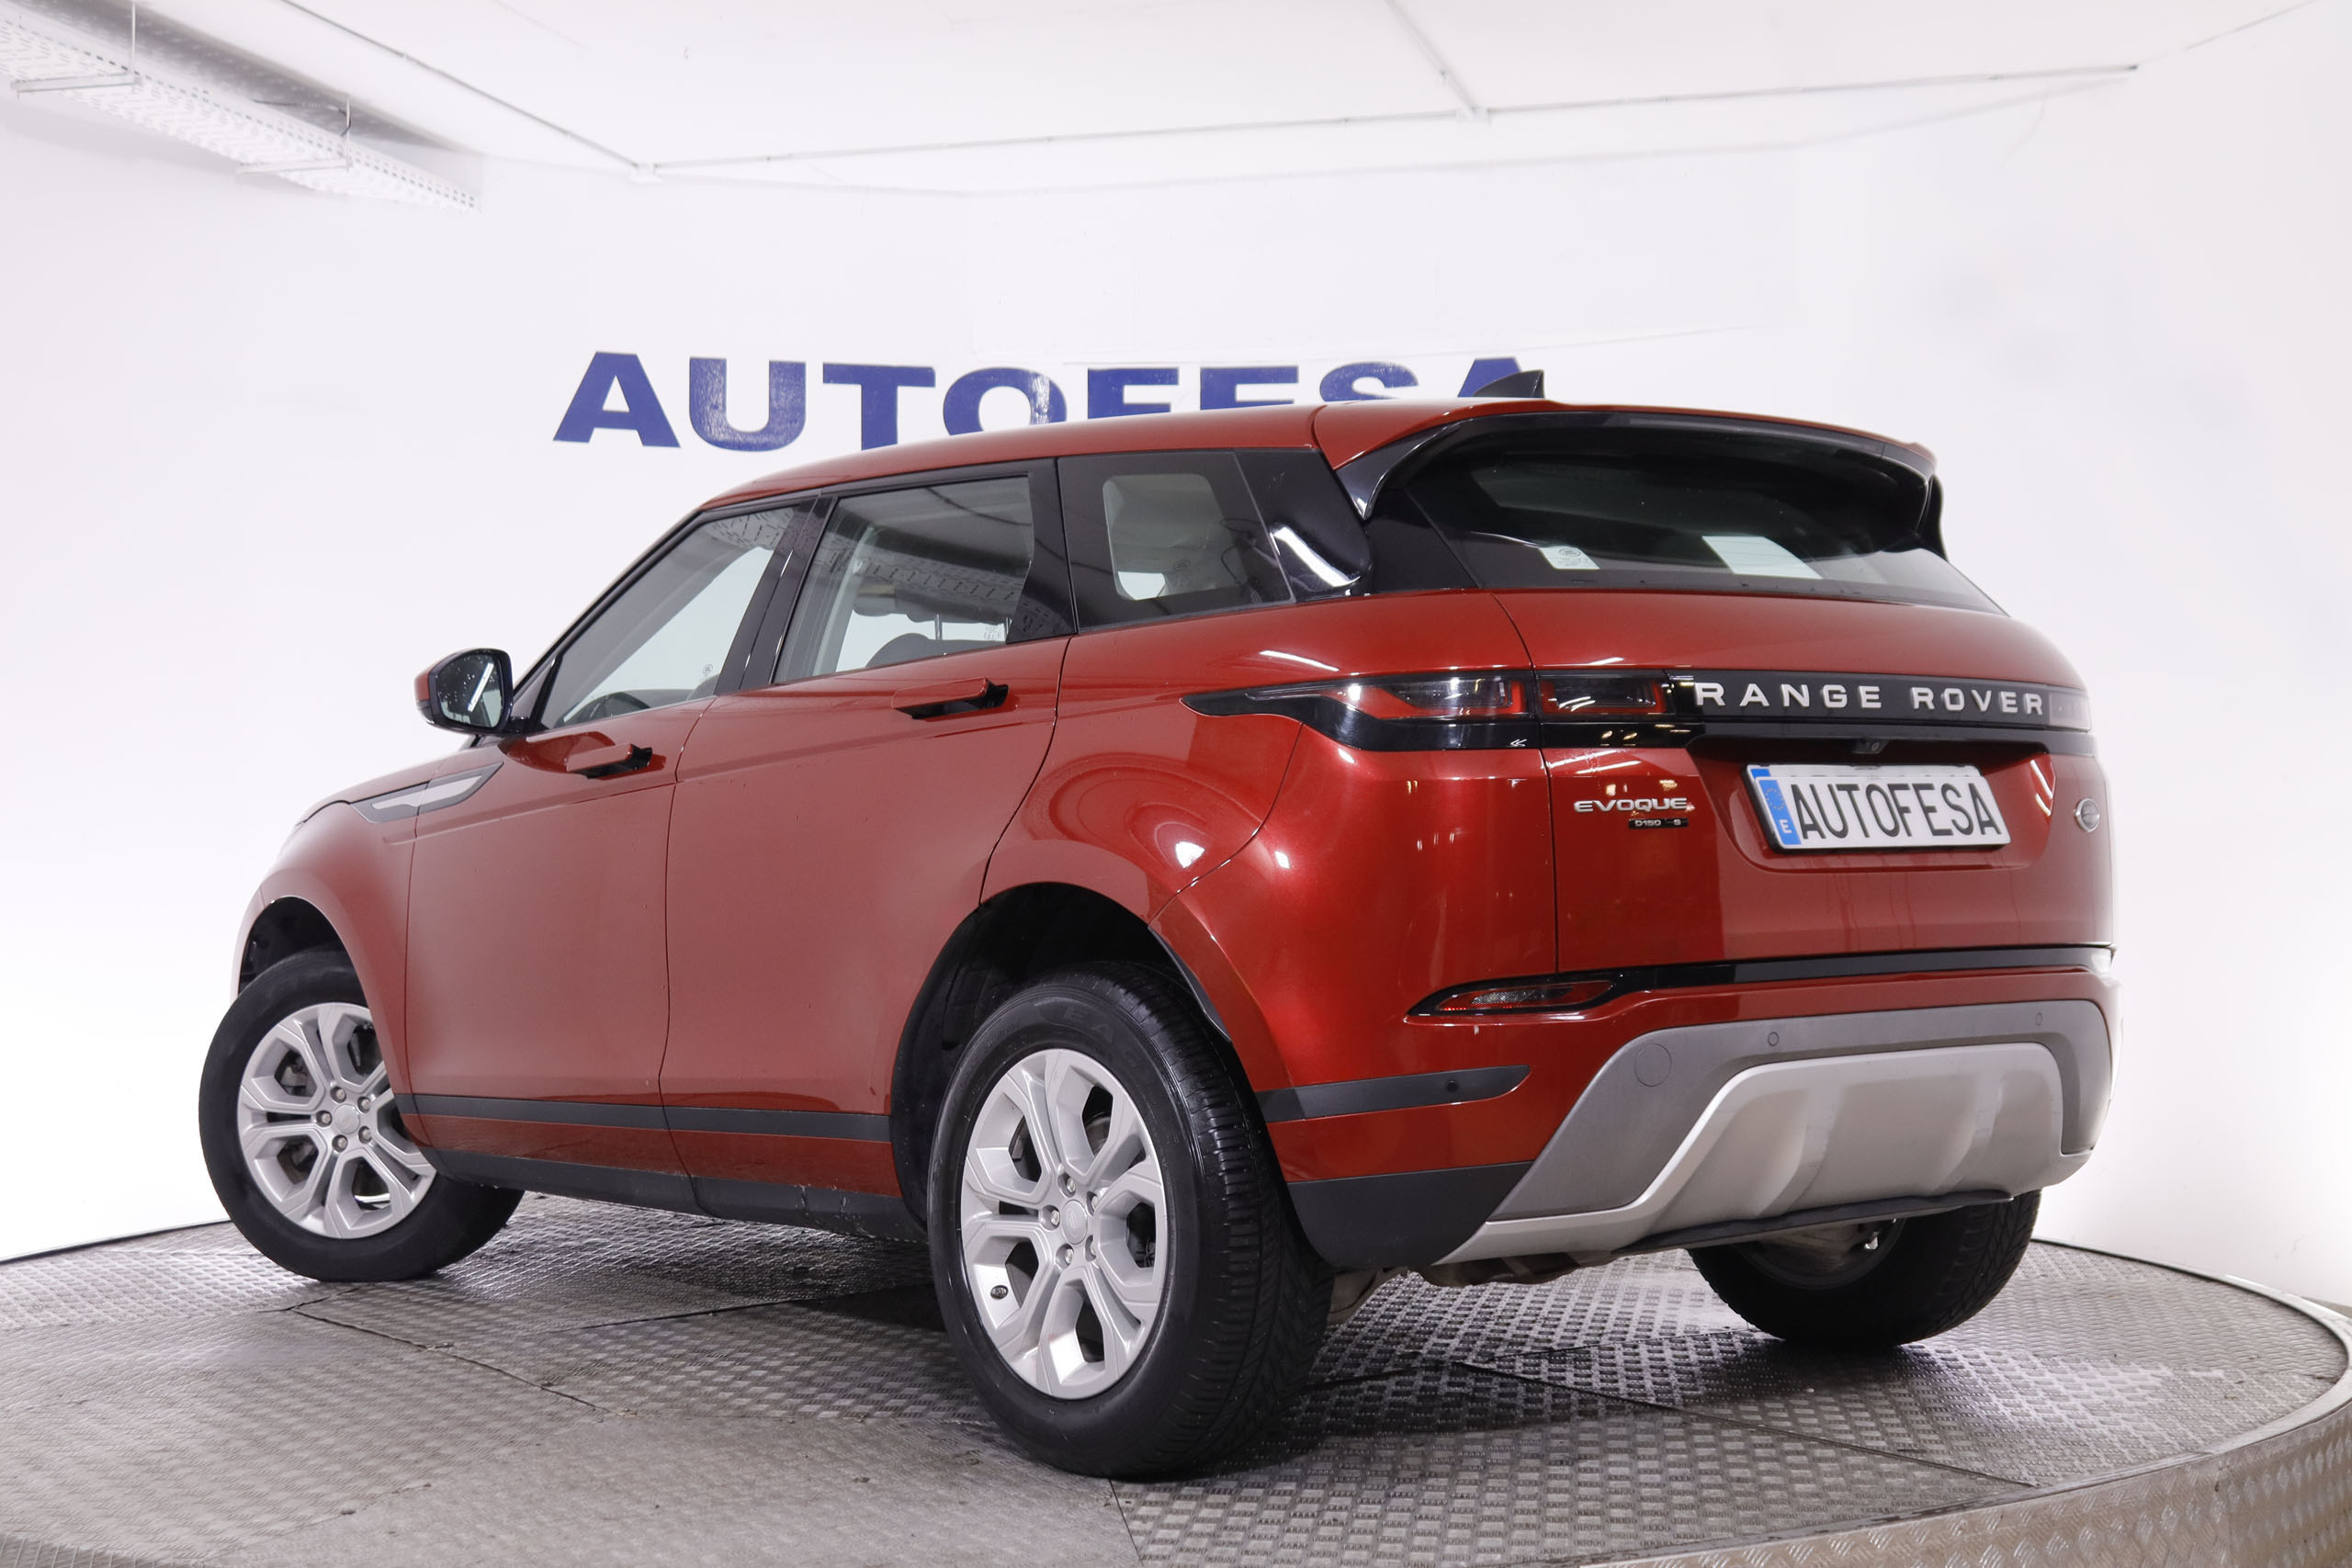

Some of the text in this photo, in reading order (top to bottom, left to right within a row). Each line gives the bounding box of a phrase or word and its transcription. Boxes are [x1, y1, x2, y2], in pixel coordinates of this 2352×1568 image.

[1694, 682, 2043, 716] RANGE ROVER
[1573, 797, 1689, 813] EVOQUE
[1791, 783, 2003, 840] AUTOFESA
[1634, 818, 1682, 828] D150 S
[1779, 818, 1792, 834] E
